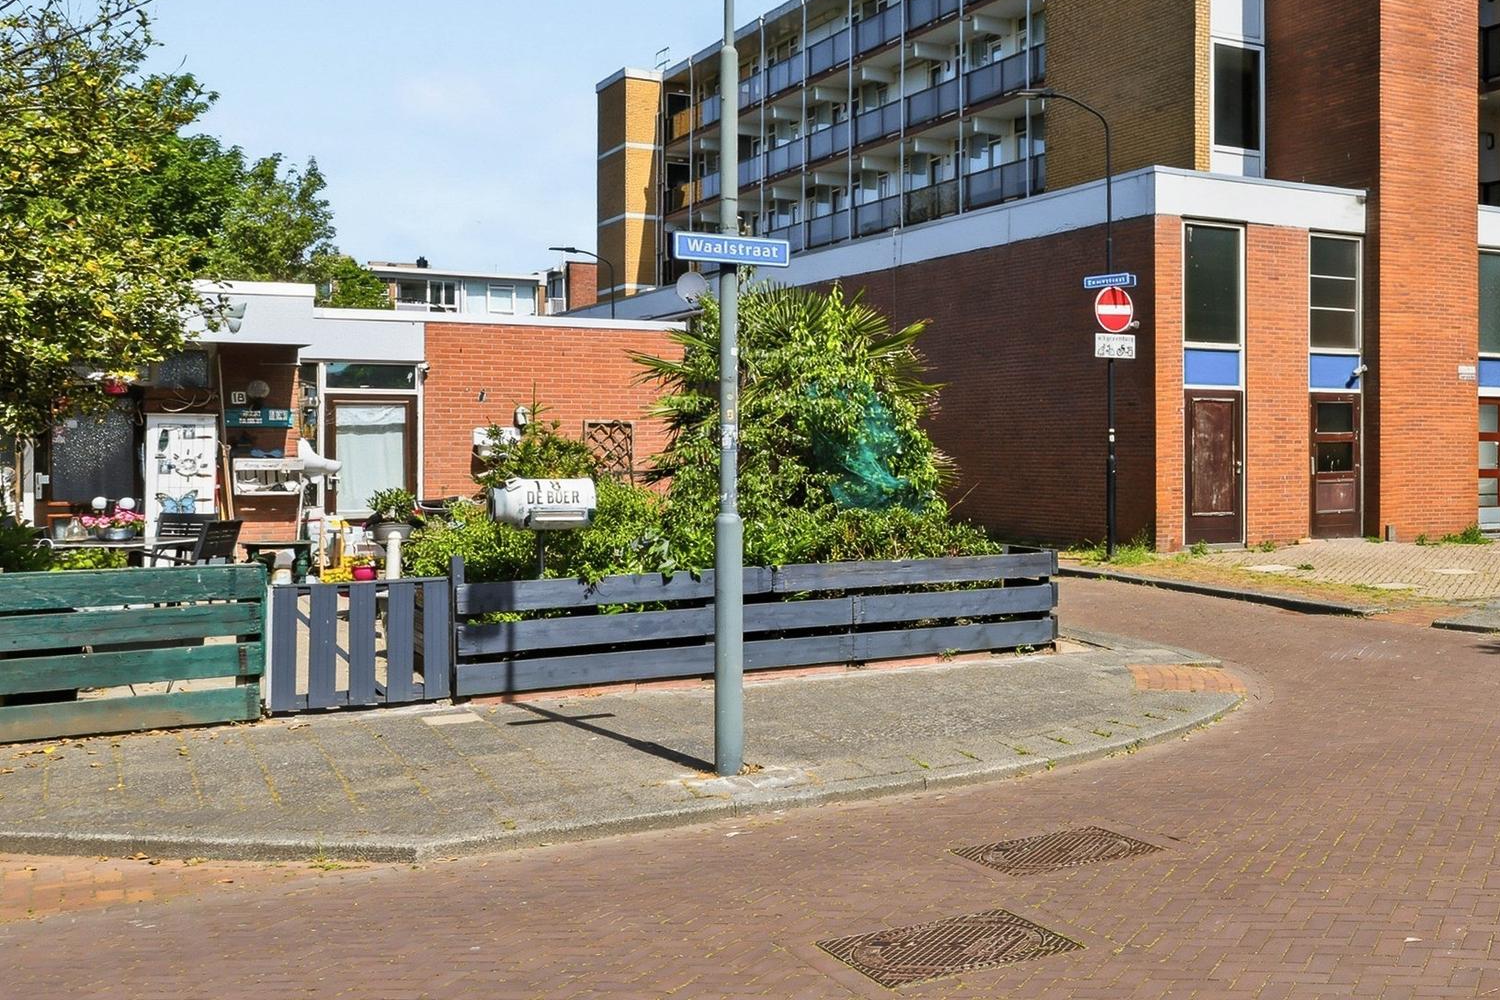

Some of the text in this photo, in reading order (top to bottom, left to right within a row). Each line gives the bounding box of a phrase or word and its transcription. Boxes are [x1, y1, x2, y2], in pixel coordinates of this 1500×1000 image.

[687, 238, 779, 258] Waalstraat
[527, 490, 580, 504] DE BOER
